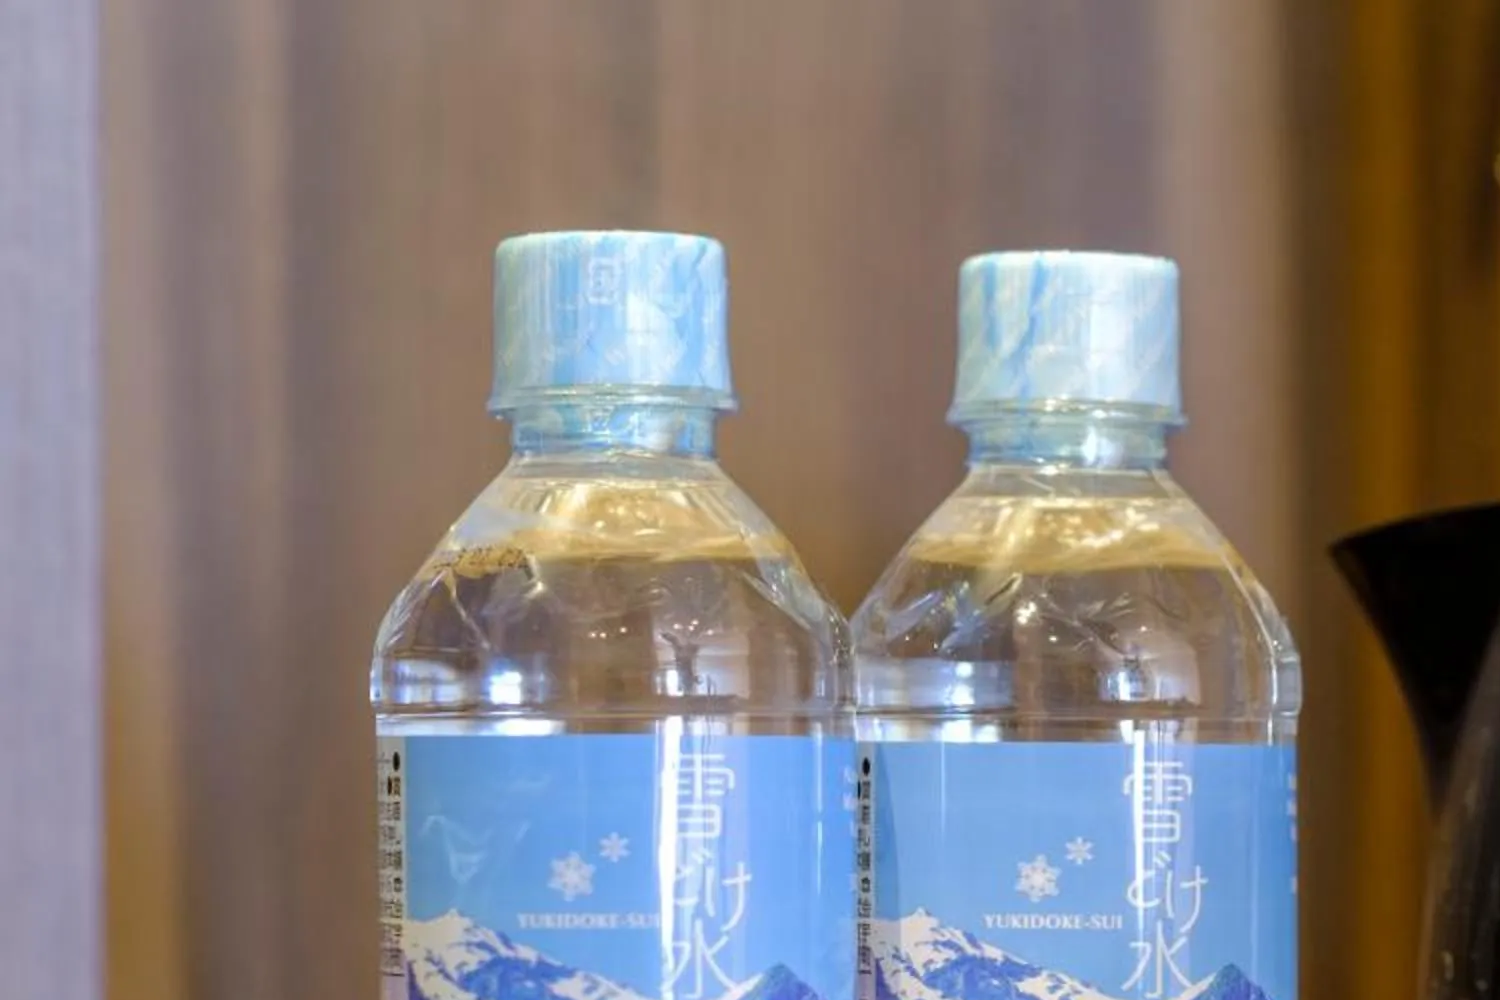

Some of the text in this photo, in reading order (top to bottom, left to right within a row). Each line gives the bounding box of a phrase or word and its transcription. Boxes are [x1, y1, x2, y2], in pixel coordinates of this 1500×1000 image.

[983, 913, 1123, 929] YUKIDOKE-SUI
[1121, 761, 1209, 998] 雪どけ水
